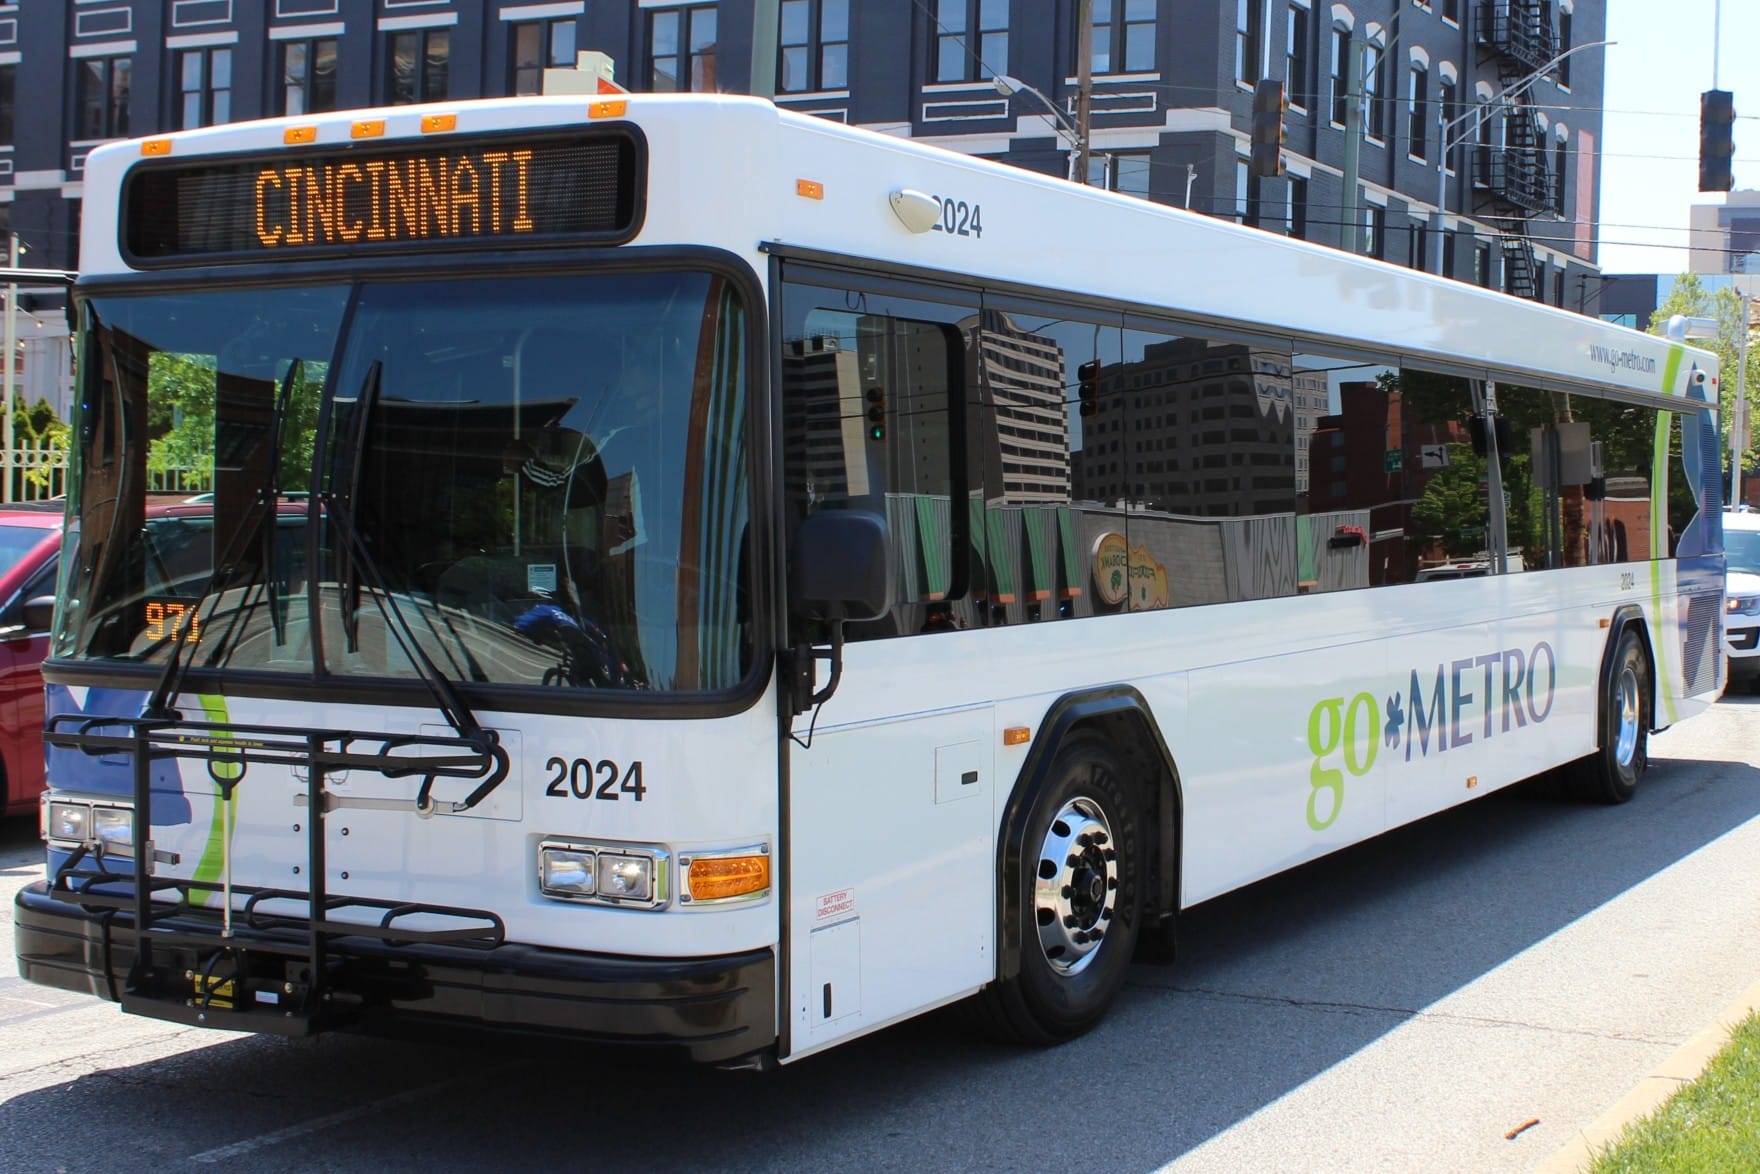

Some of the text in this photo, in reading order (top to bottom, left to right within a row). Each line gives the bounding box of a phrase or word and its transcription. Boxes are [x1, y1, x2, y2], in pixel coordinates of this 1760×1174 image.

[256, 150, 533, 246] CINCINNATI
[1590, 343, 1656, 374] www.go-metro.com
[1621, 571, 1635, 591] 2024
[1306, 640, 1555, 831] go METRO
[545, 756, 647, 802] 2024
[817, 899, 854, 917] DISCONNECT
[823, 892, 848, 906] BATTERY
